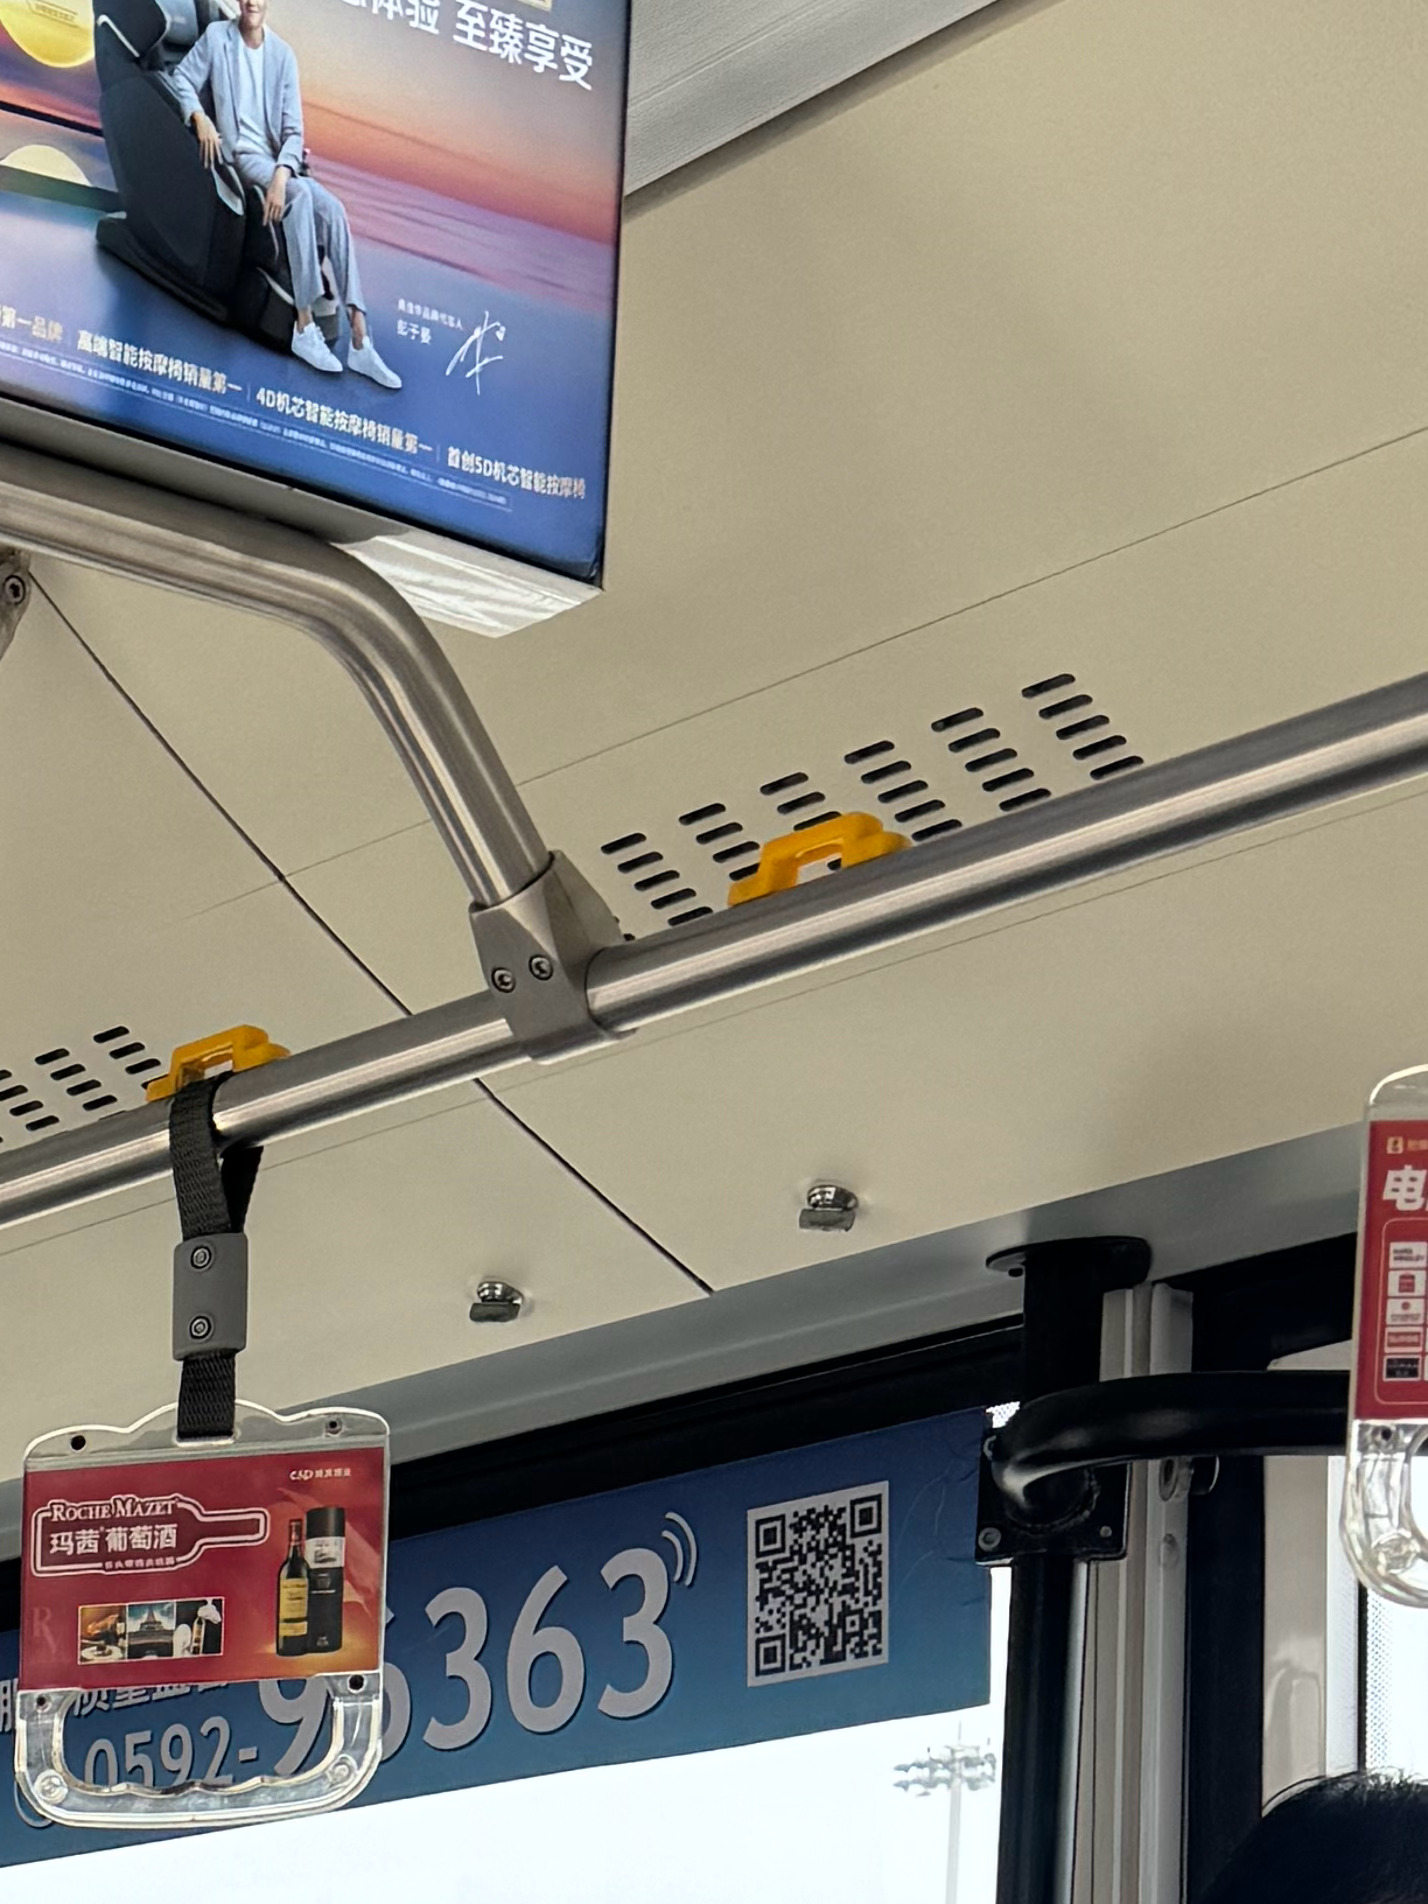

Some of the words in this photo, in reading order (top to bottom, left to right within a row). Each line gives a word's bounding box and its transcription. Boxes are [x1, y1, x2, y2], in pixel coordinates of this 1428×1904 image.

[452, 0, 593, 91] 至臻享受
[76, 329, 243, 395] 高端智能按摩椅销量第一
[256, 387, 434, 455] 4D机芯智能按摩椅销量第一
[446, 445, 587, 500] 首创5D机芯智能按摩椅
[1383, 1165, 1428, 1211] 电
[51, 1501, 111, 1523] ROCHE
[115, 1498, 175, 1519] MAZET
